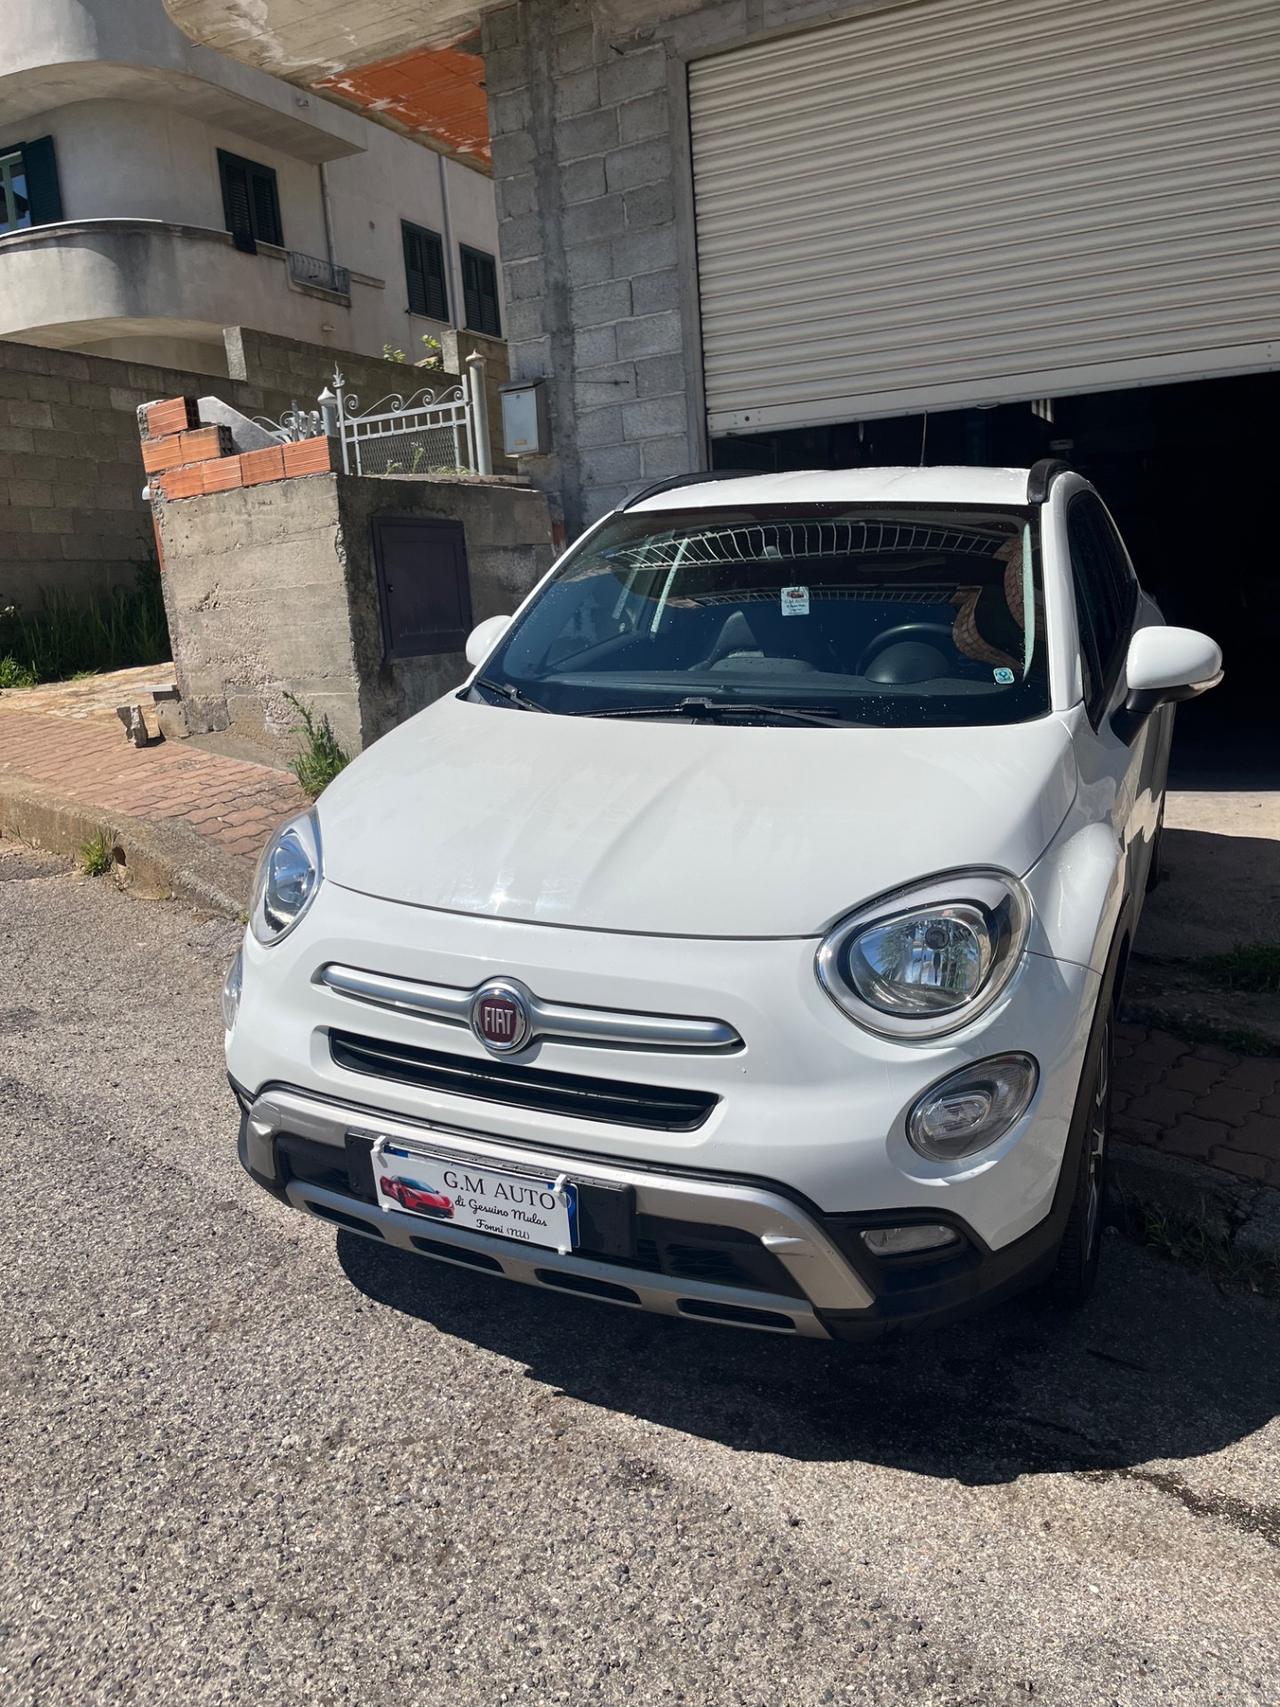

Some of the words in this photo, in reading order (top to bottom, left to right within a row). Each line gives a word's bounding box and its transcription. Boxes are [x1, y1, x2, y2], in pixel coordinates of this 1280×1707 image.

[484, 1006, 514, 1035] FIAT
[443, 1171, 487, 1196] G.M
[494, 1182, 556, 1210] AUTO
[454, 1195, 466, 1208] di
[468, 1198, 509, 1217] Gesuino
[511, 1209, 548, 1227] Mulas
[475, 1218, 504, 1234] Fonni
